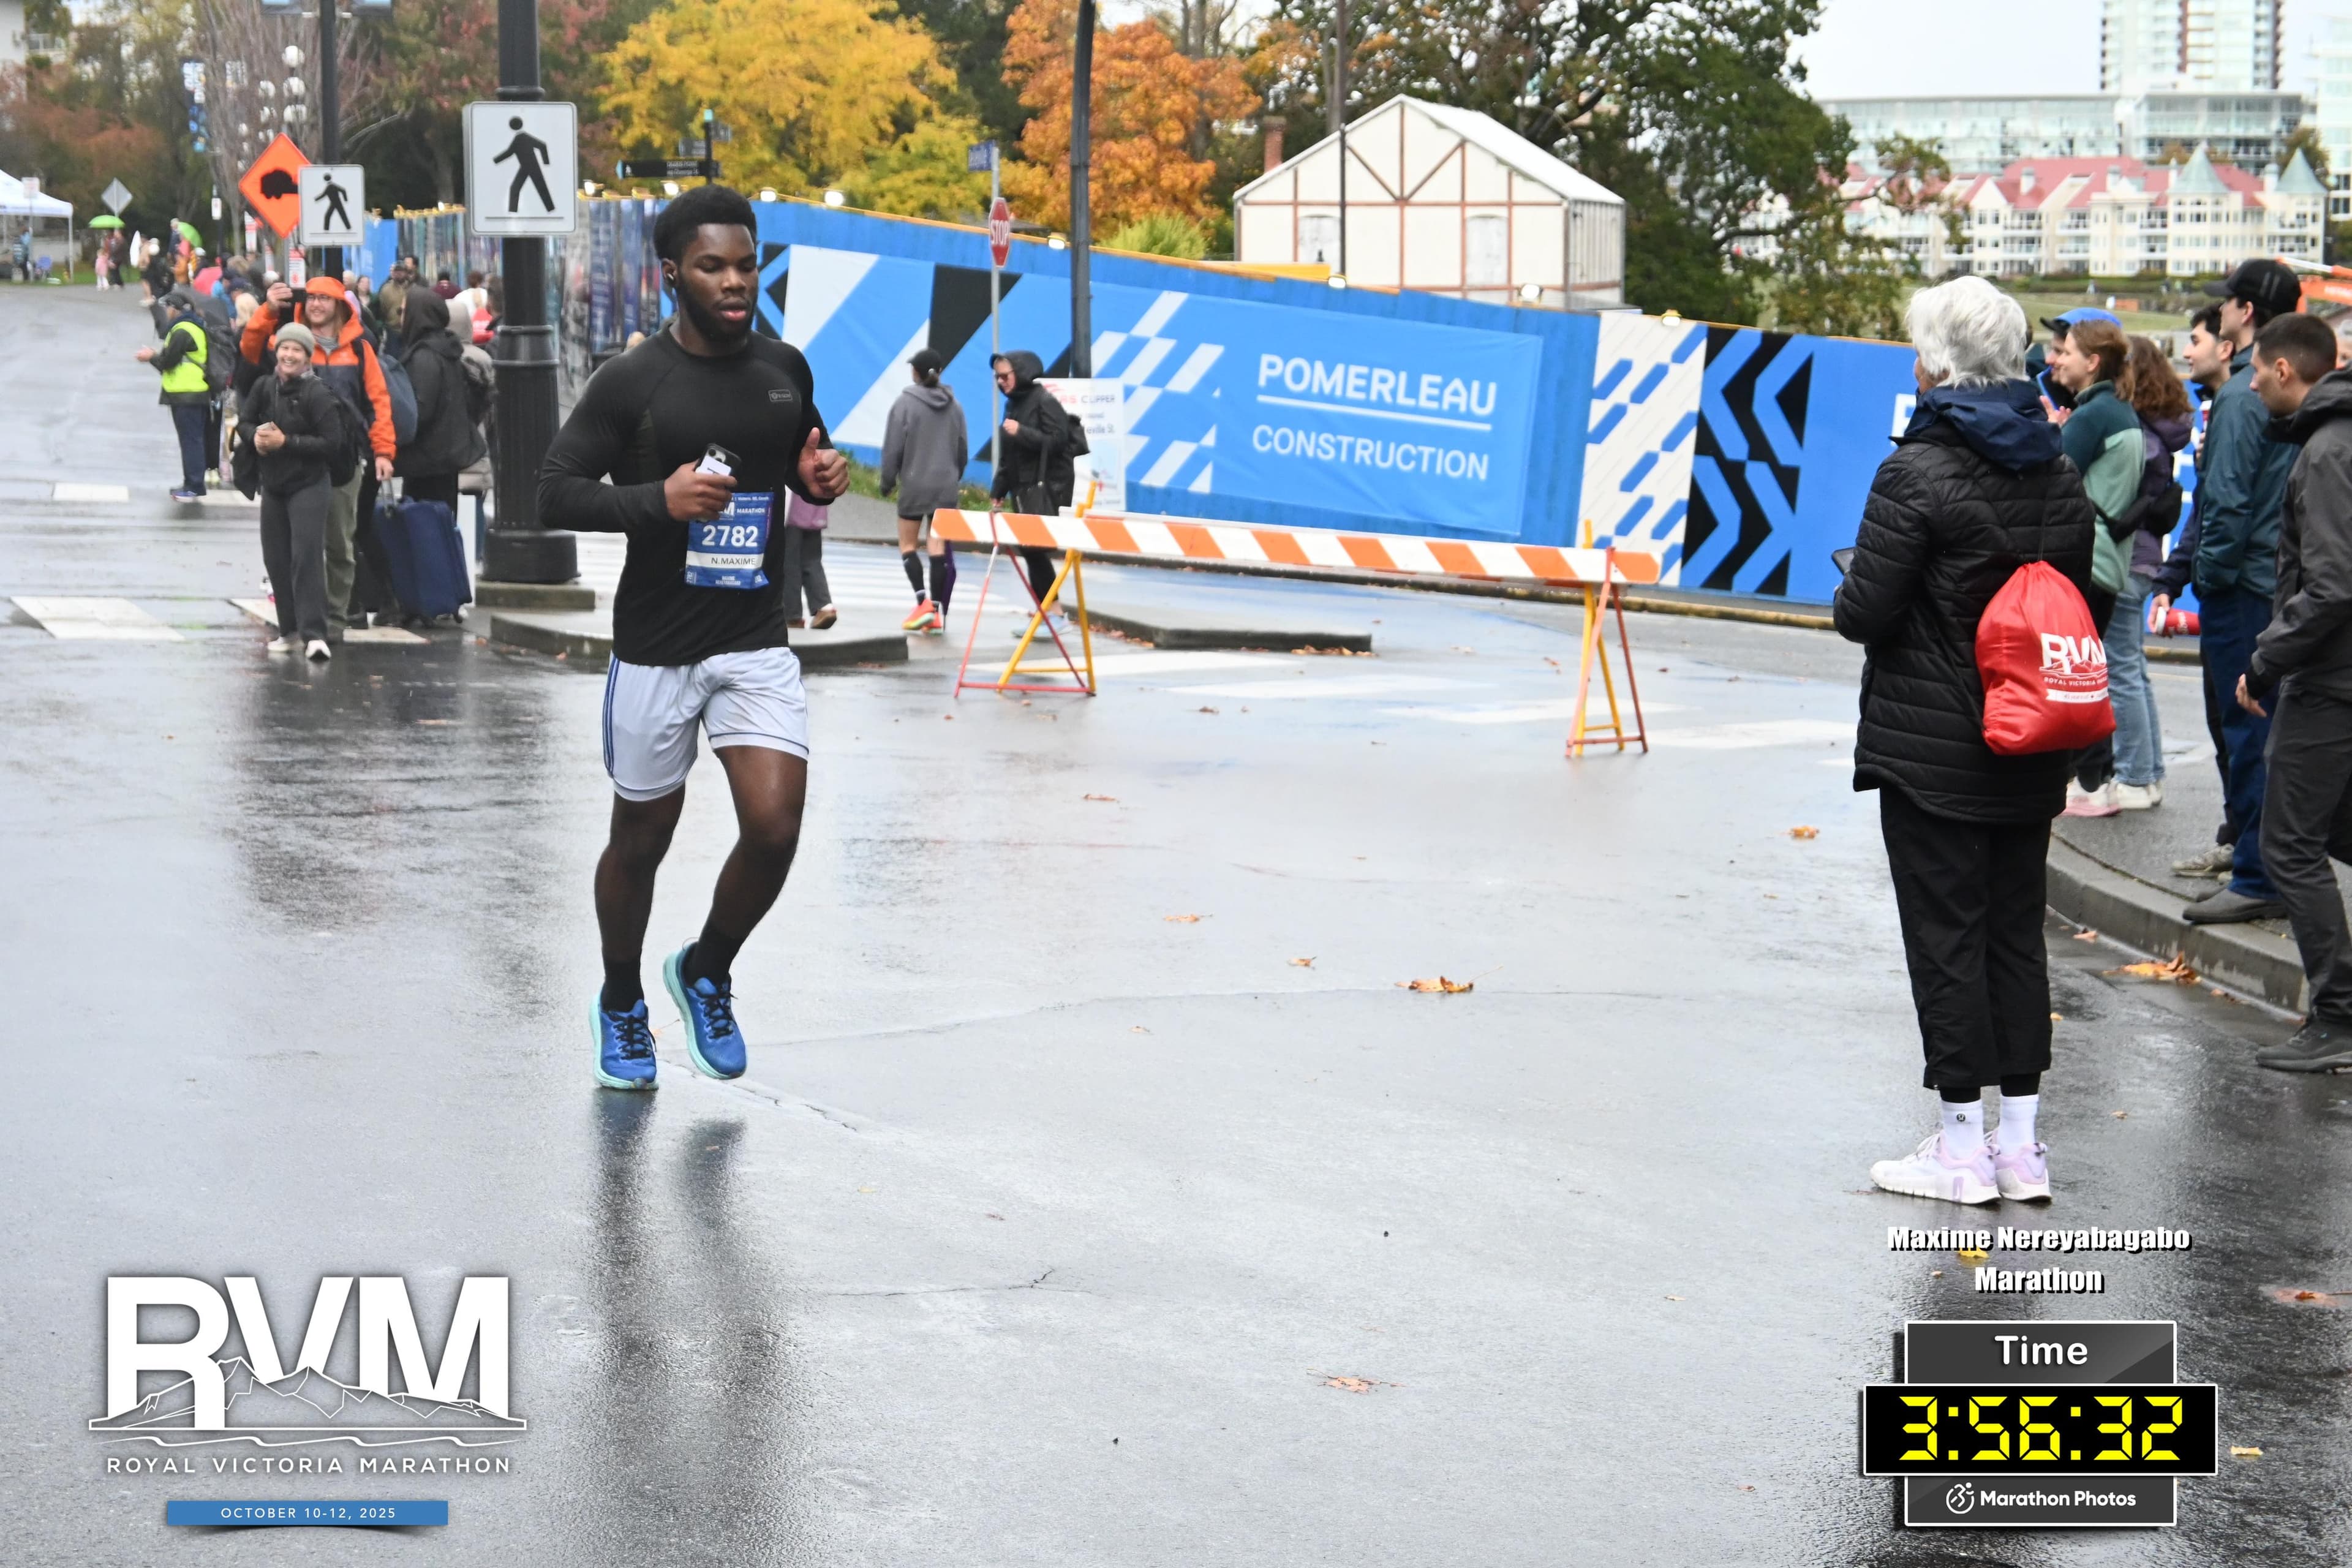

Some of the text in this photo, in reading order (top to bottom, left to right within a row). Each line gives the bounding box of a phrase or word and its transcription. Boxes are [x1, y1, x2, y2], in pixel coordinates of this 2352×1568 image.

[991, 220, 1009, 246] STOP
[1257, 353, 1497, 415] POMERLEAU
[1252, 424, 1489, 481] CONSTRUCTION
[702, 525, 758, 547] 2782
[710, 557, 756, 565] N.MAXIME
[2043, 676, 2067, 685] ROYAL
